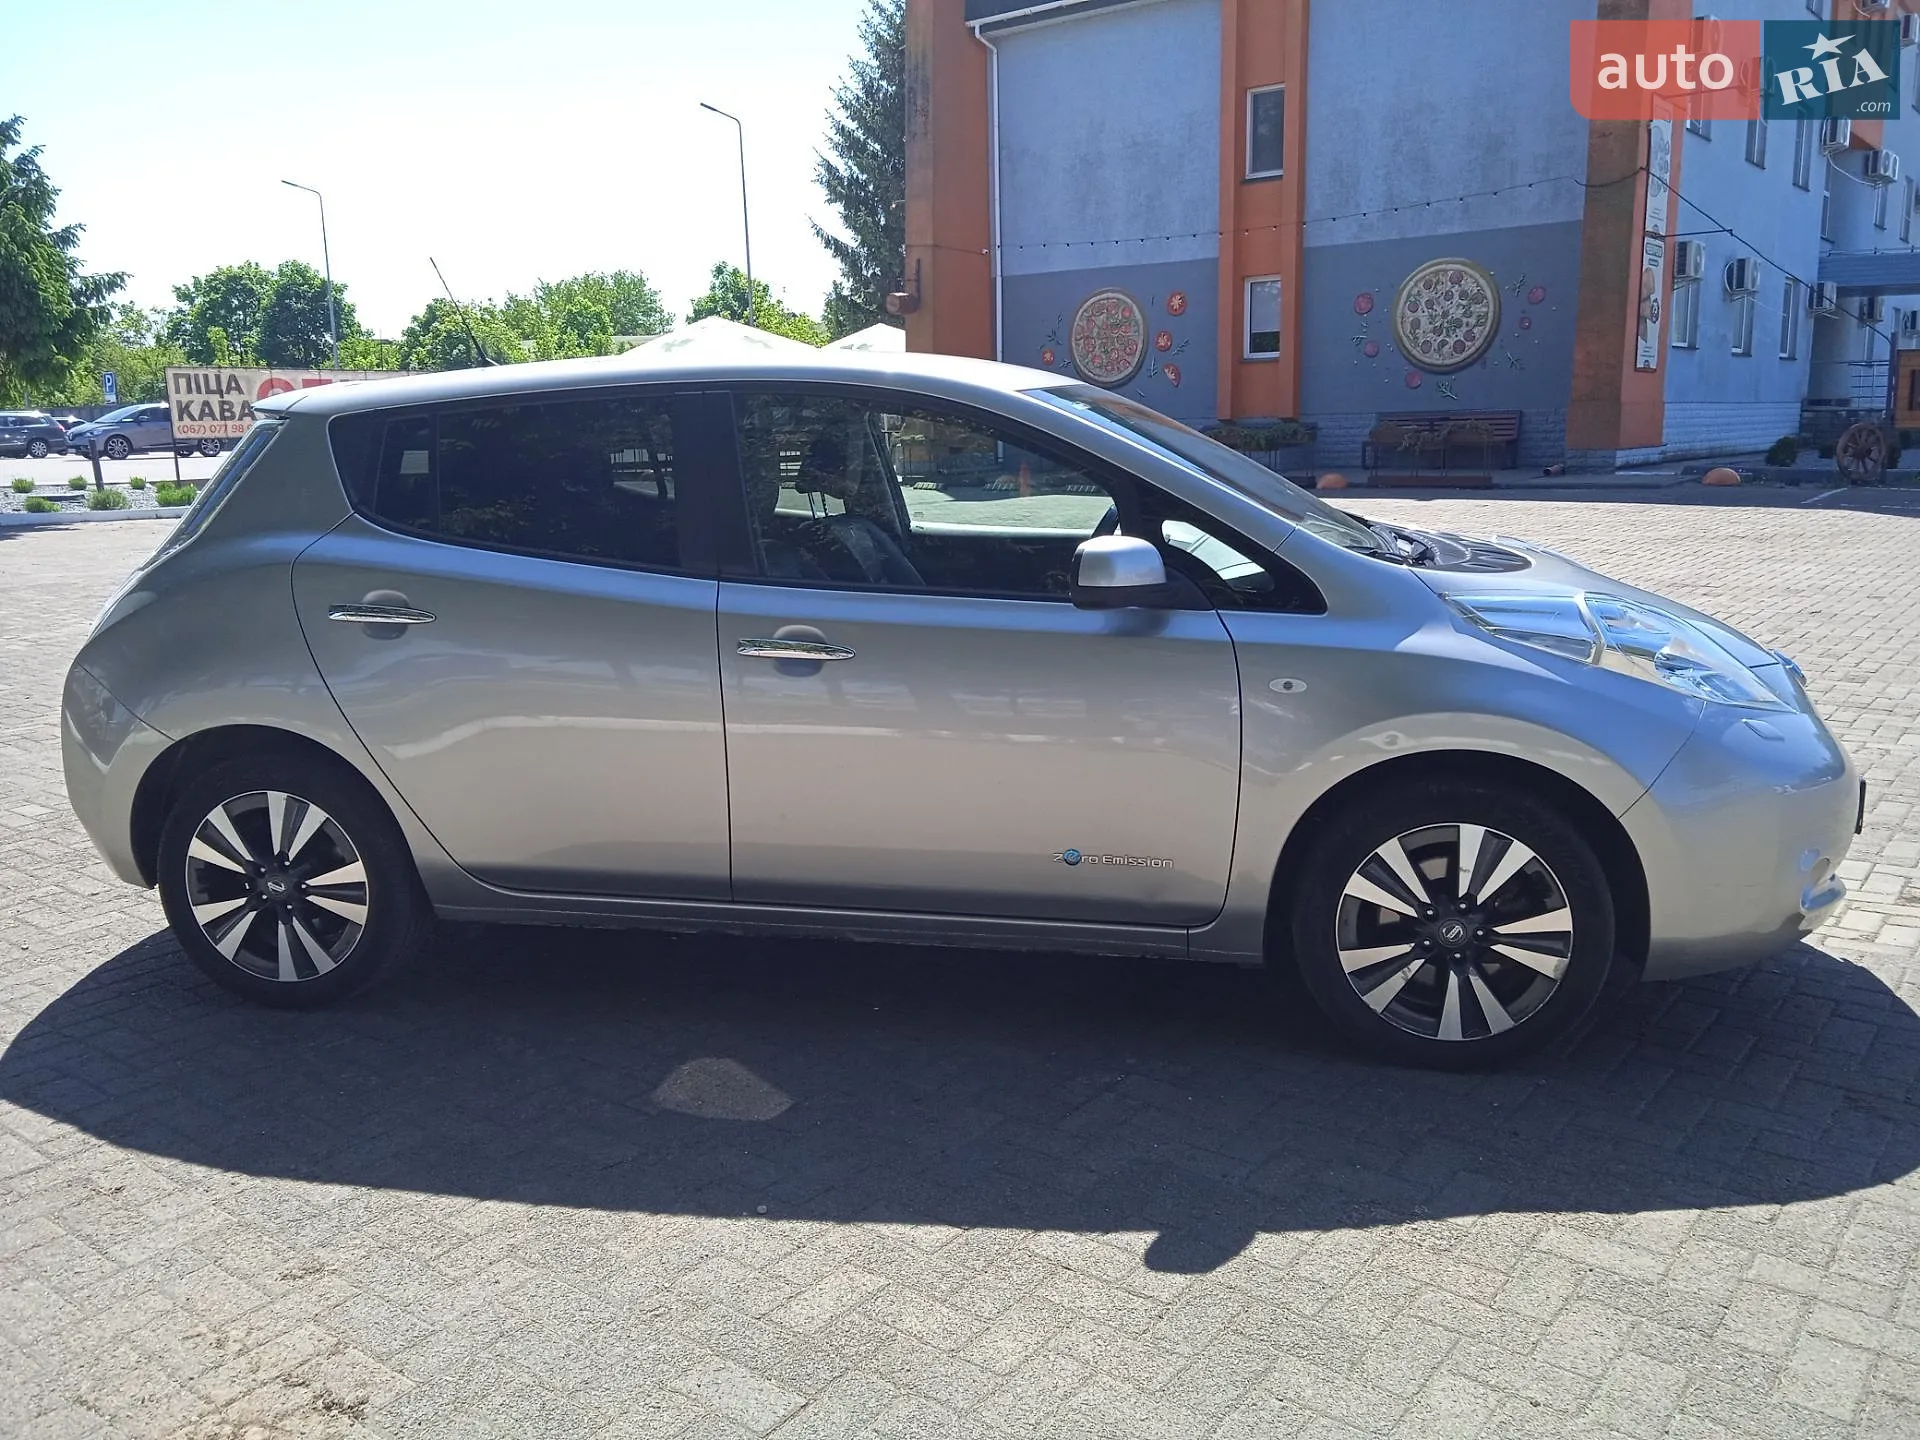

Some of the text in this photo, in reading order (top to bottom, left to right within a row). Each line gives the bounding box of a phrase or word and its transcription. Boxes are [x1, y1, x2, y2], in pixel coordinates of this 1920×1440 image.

[105, 374, 113, 392] P
[173, 373, 244, 399] ПІЦА
[176, 400, 257, 422] КАВА
[1102, 855, 1174, 869] Emission
